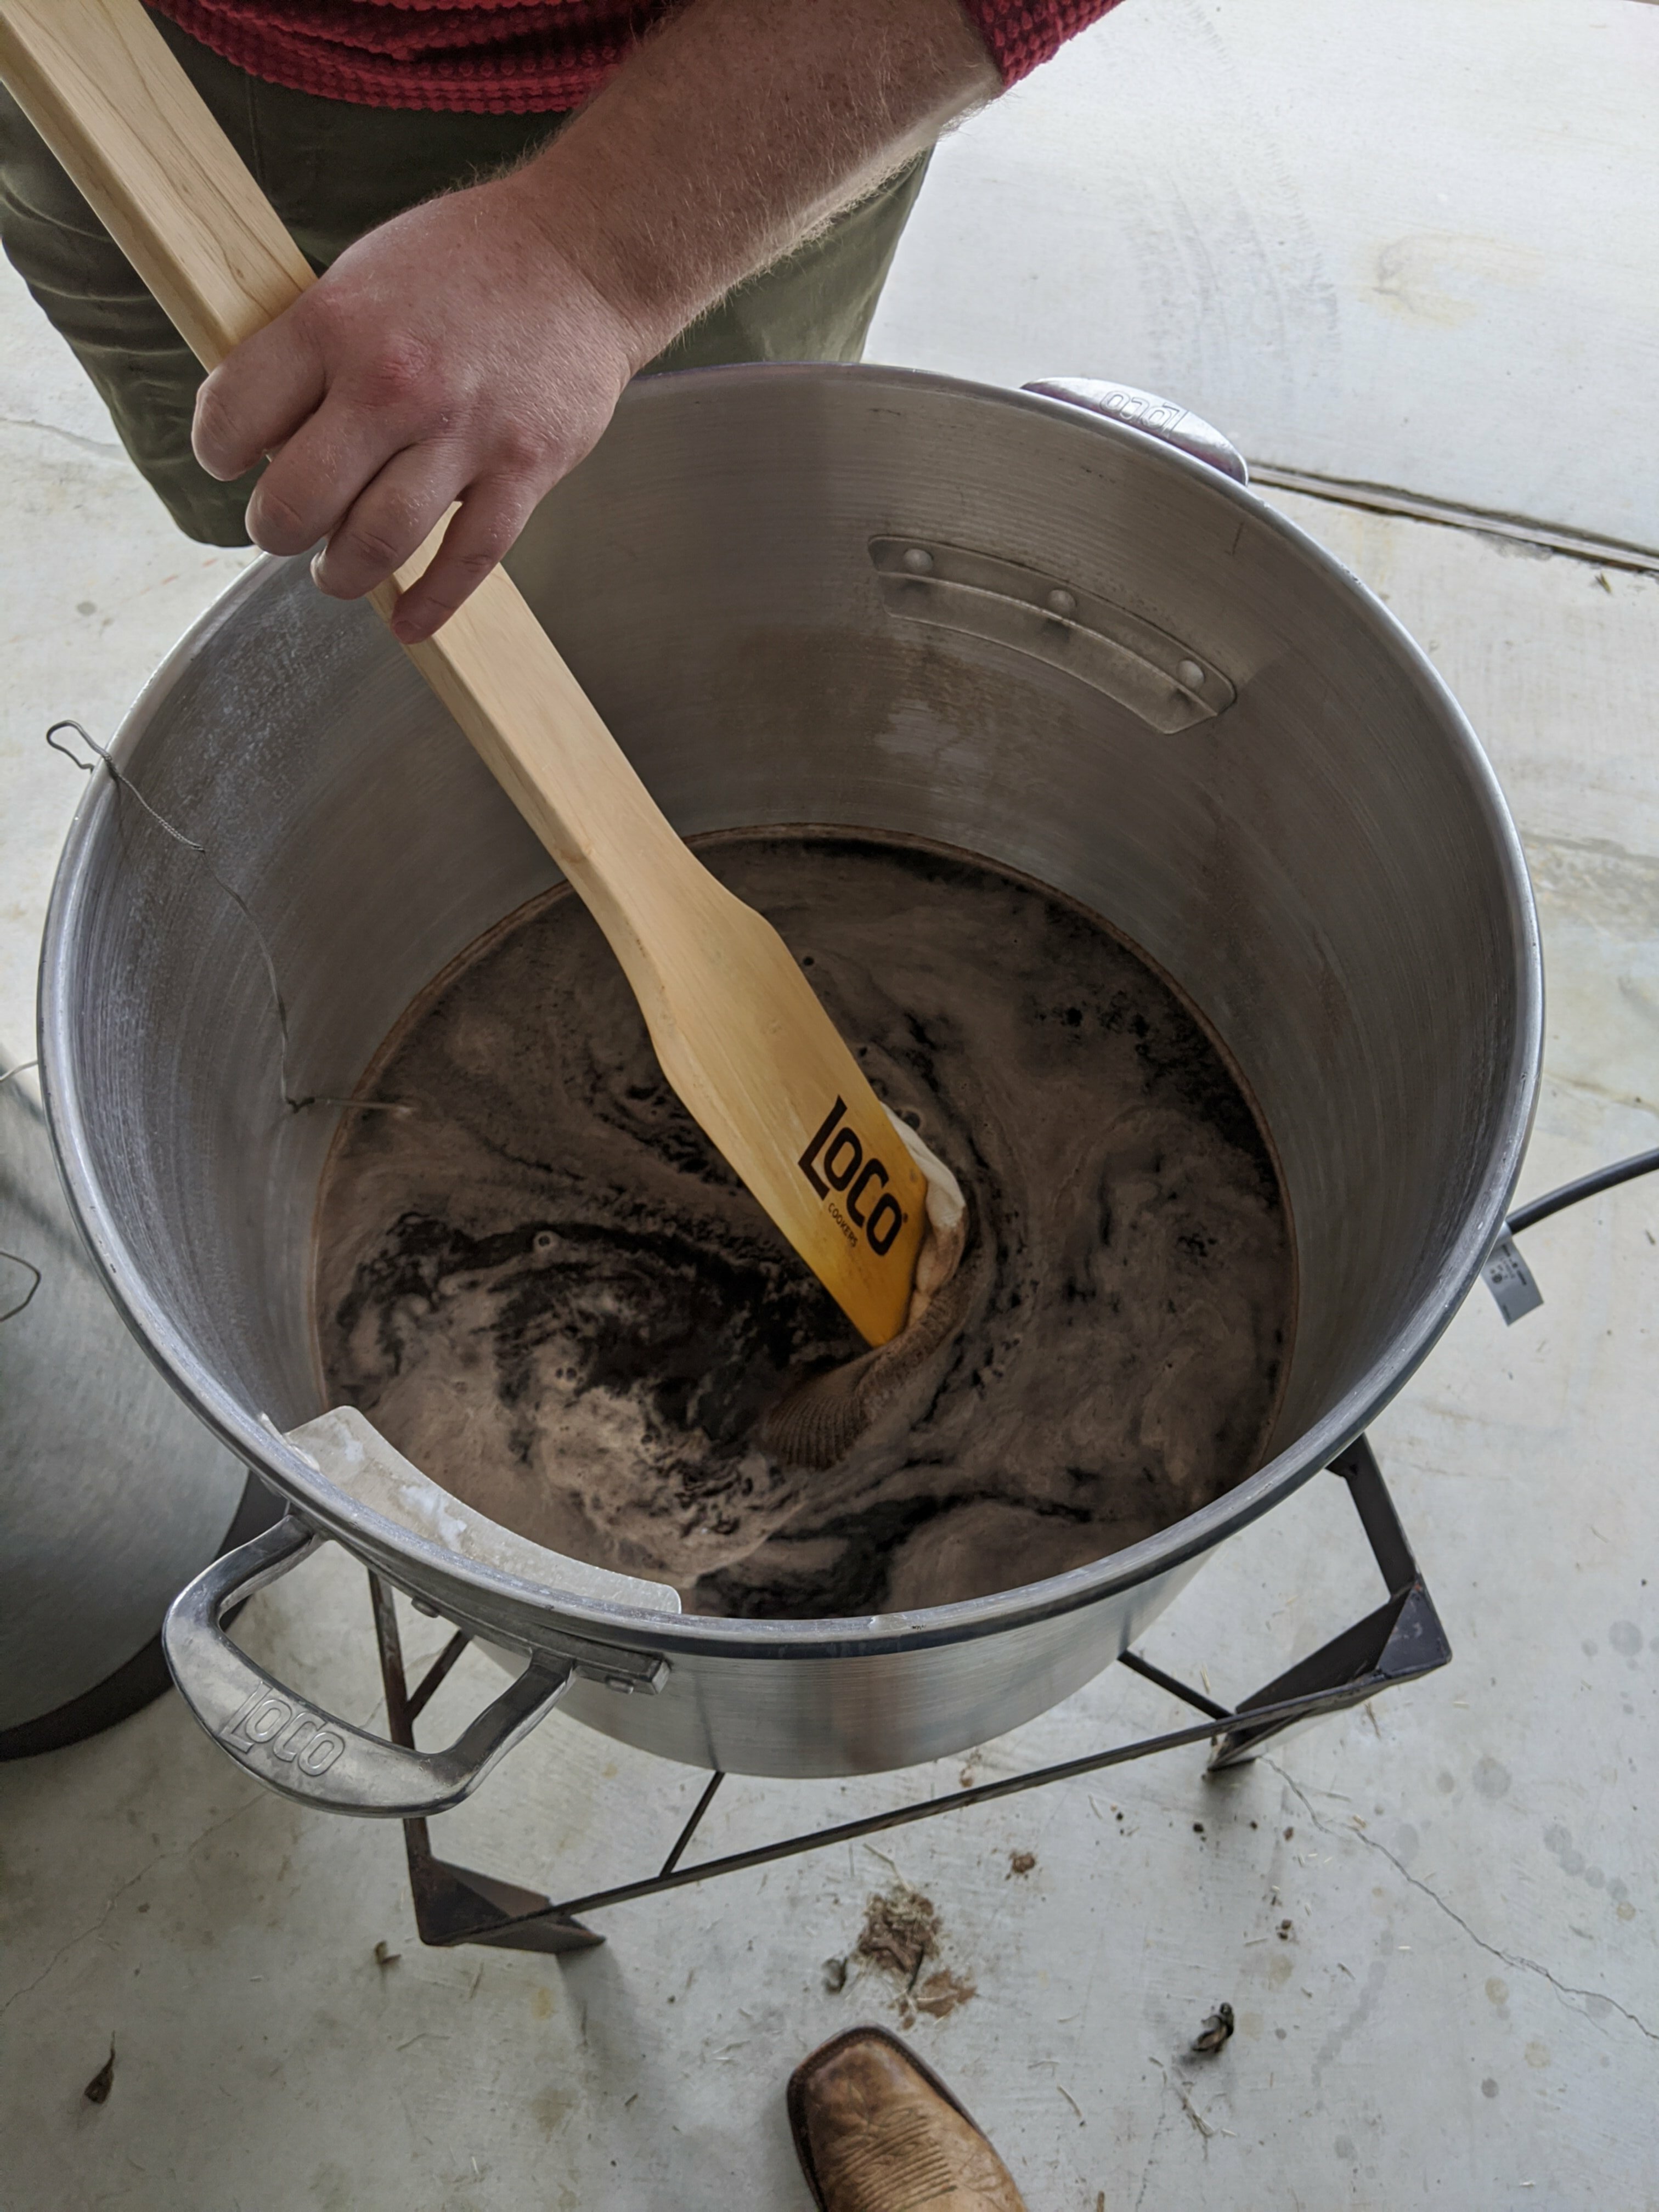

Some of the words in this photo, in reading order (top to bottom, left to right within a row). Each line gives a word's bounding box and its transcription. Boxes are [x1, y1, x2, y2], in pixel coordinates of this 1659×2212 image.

[1100, 391, 1188, 438] LOCO
[798, 1094, 902, 1256] LOCO
[828, 1202, 858, 1248] COOKERS
[219, 1680, 346, 1777] LOCO
